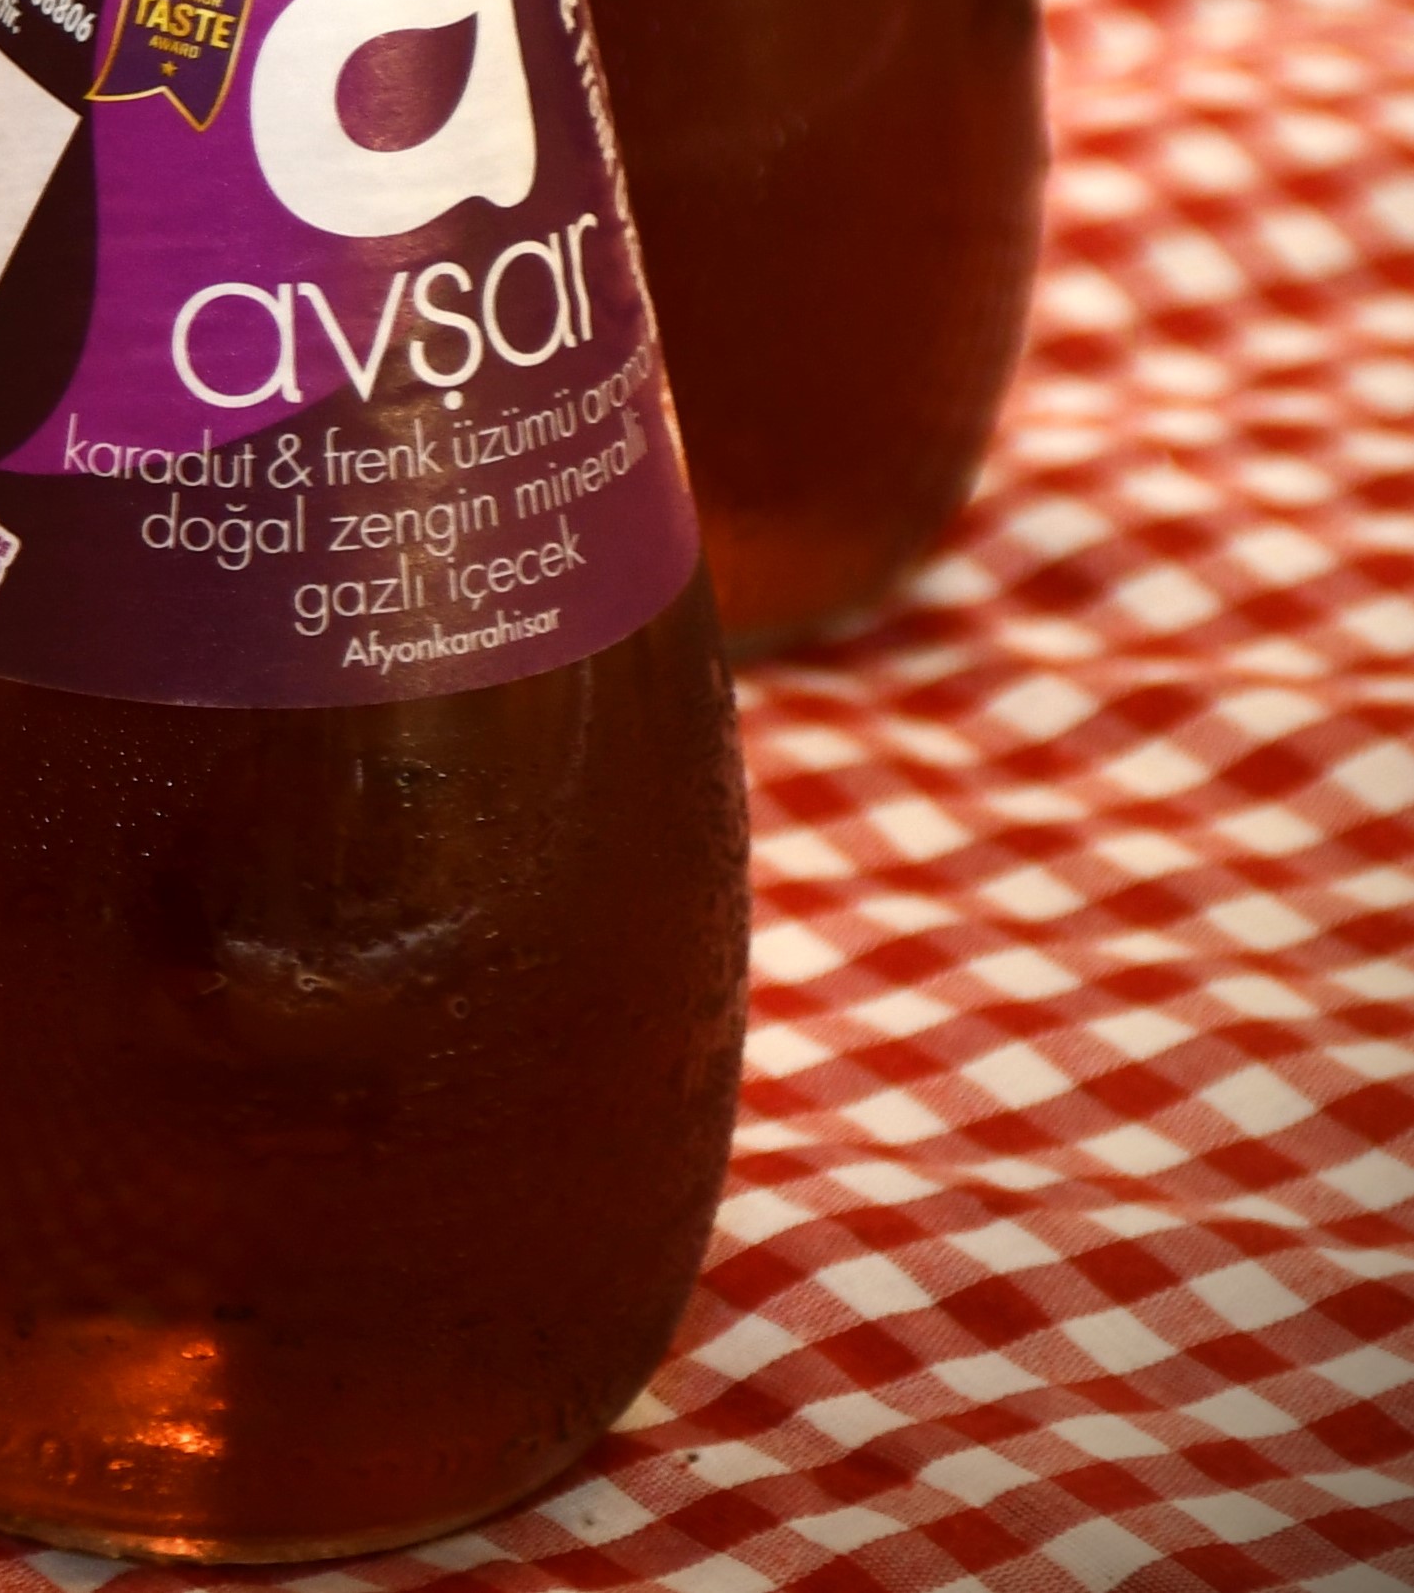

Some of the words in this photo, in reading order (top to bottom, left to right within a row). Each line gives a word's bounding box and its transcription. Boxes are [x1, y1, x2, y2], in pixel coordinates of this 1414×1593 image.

[149, 35, 202, 59] AWARD
[172, 212, 597, 410] avşar
[64, 413, 255, 489] karadut
[268, 433, 313, 489] &
[324, 419, 443, 486] frenk
[453, 389, 578, 470] üzümü
[141, 492, 306, 571] doğal
[329, 491, 500, 557] zengin
[293, 554, 425, 636] gazlı
[449, 515, 587, 611] içecek
[342, 608, 561, 675] Afyonkarahisar
